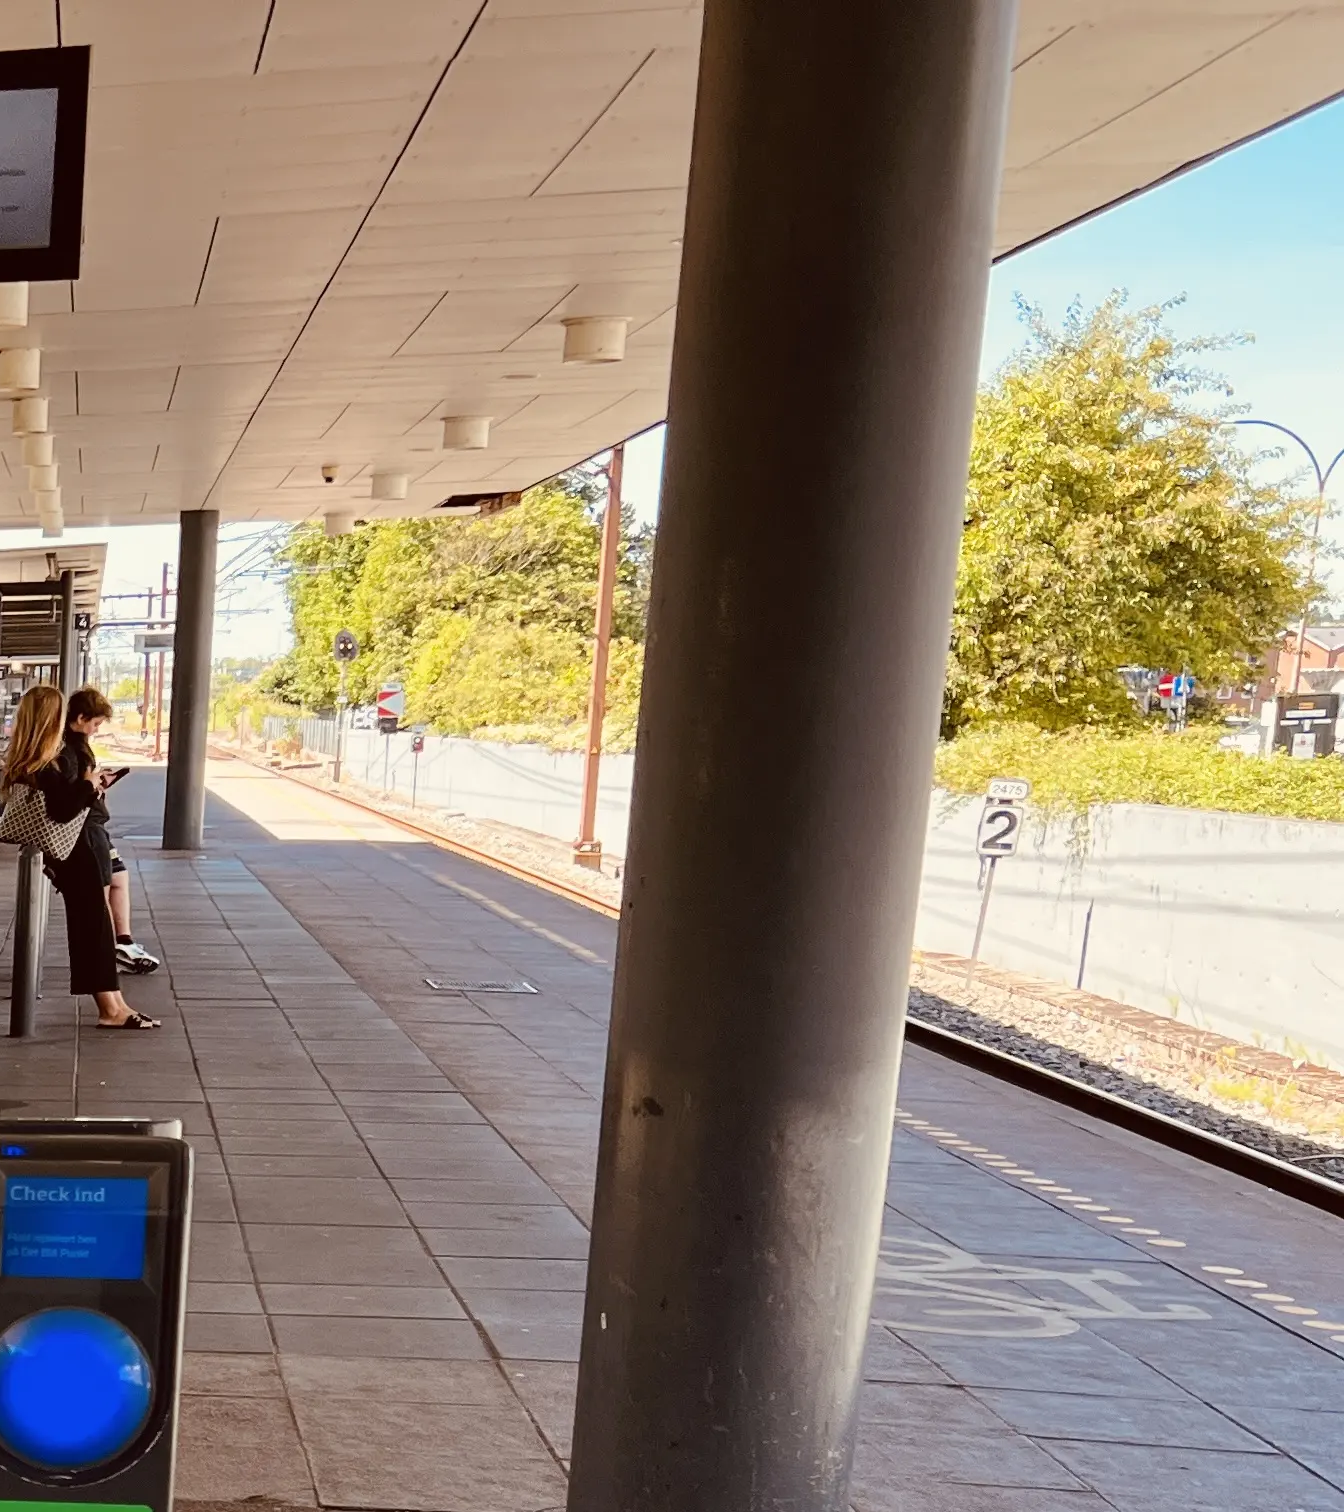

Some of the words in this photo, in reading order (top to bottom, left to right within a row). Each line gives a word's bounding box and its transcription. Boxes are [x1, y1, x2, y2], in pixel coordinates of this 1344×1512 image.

[993, 784, 1023, 796] 2475
[982, 810, 1017, 850] 2
[10, 1185, 70, 1202] Check
[74, 1186, 105, 1202] ind
